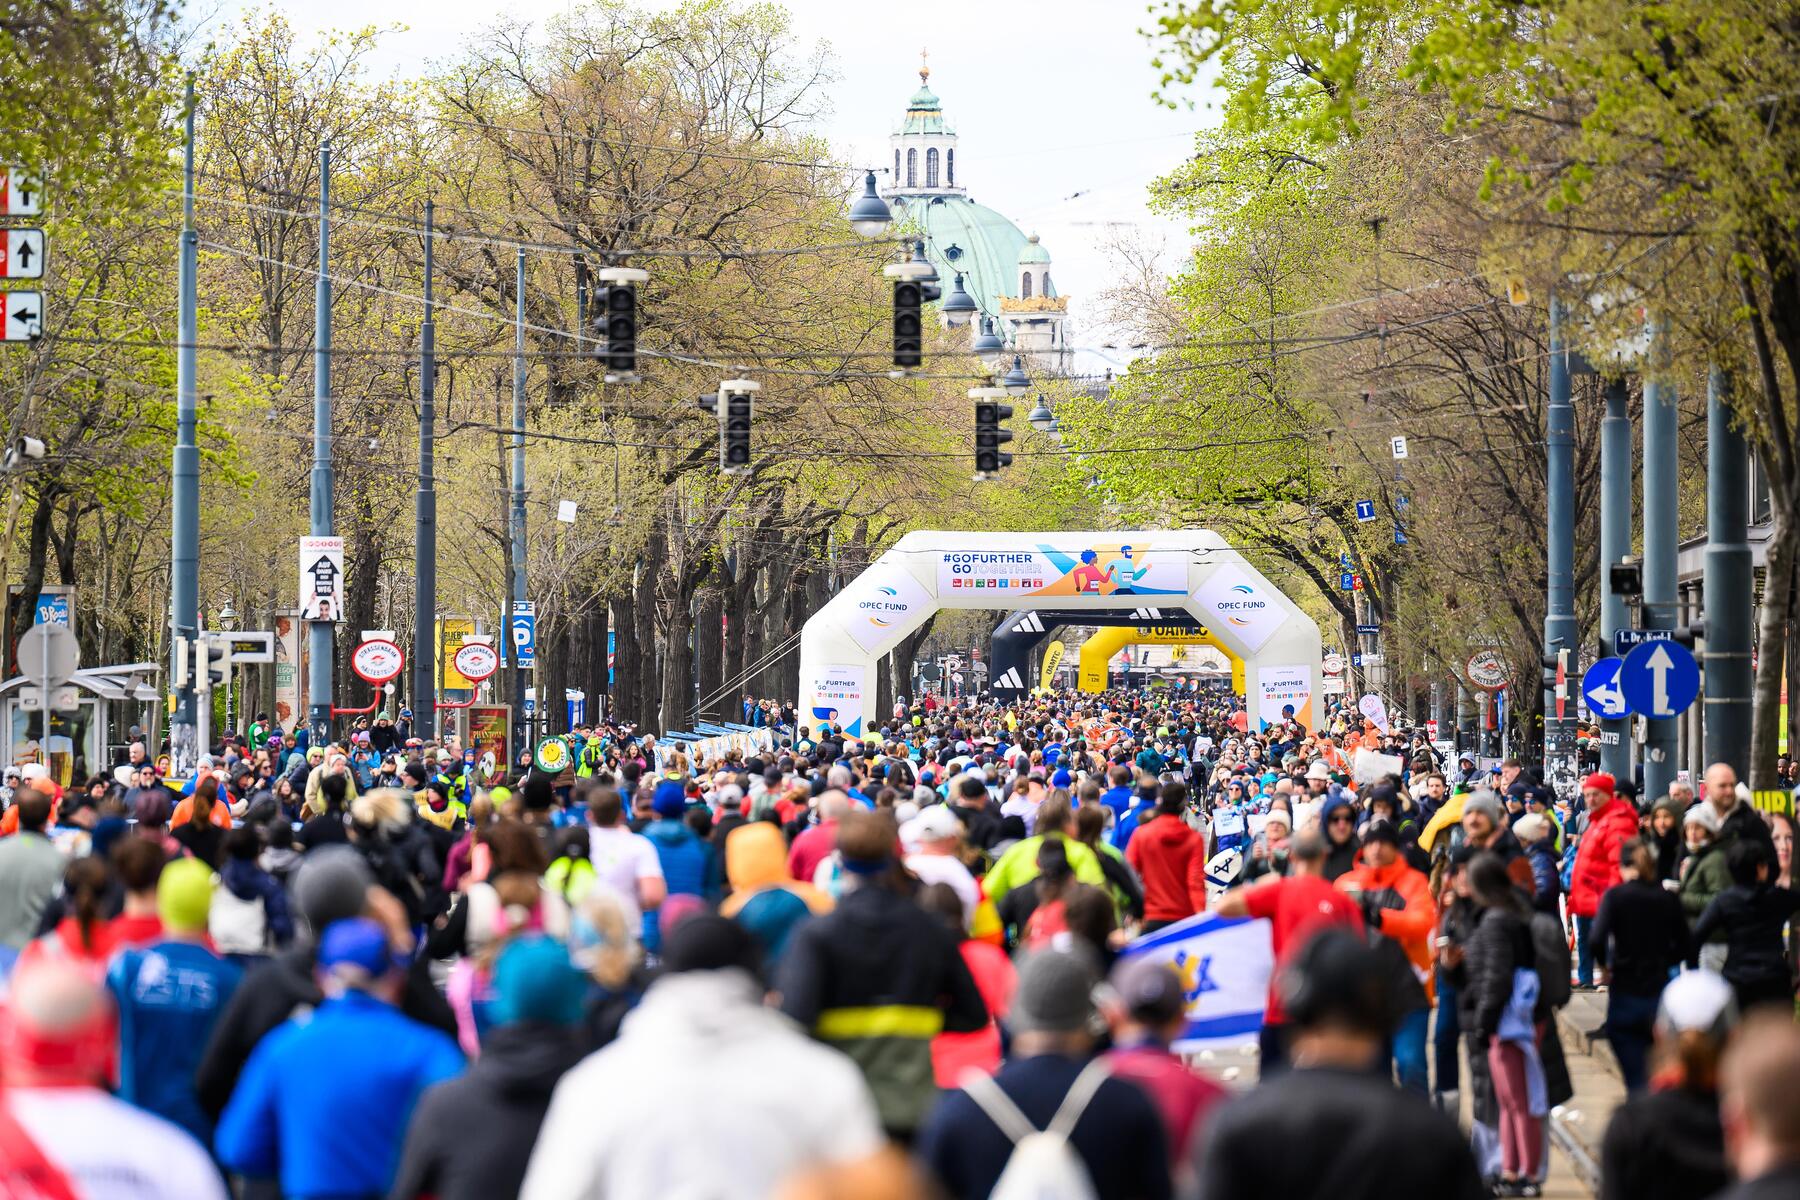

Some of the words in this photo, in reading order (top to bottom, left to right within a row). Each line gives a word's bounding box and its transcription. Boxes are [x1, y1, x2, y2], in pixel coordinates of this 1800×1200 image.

[1394, 440, 1404, 454] E
[1358, 502, 1371, 517] T
[943, 554, 1032, 563] #GOFURTHER
[859, 602, 882, 610] OPEC
[885, 603, 908, 611] FUND
[1217, 602, 1241, 610] OPEC
[1243, 601, 1266, 609] FUND
[513, 628, 531, 655] P
[358, 645, 398, 658] STRASSENBAHN
[459, 647, 494, 659] STRASSENBAHN
[360, 665, 396, 676] HALTESTELLE
[460, 665, 493, 675] HALTESTELLE
